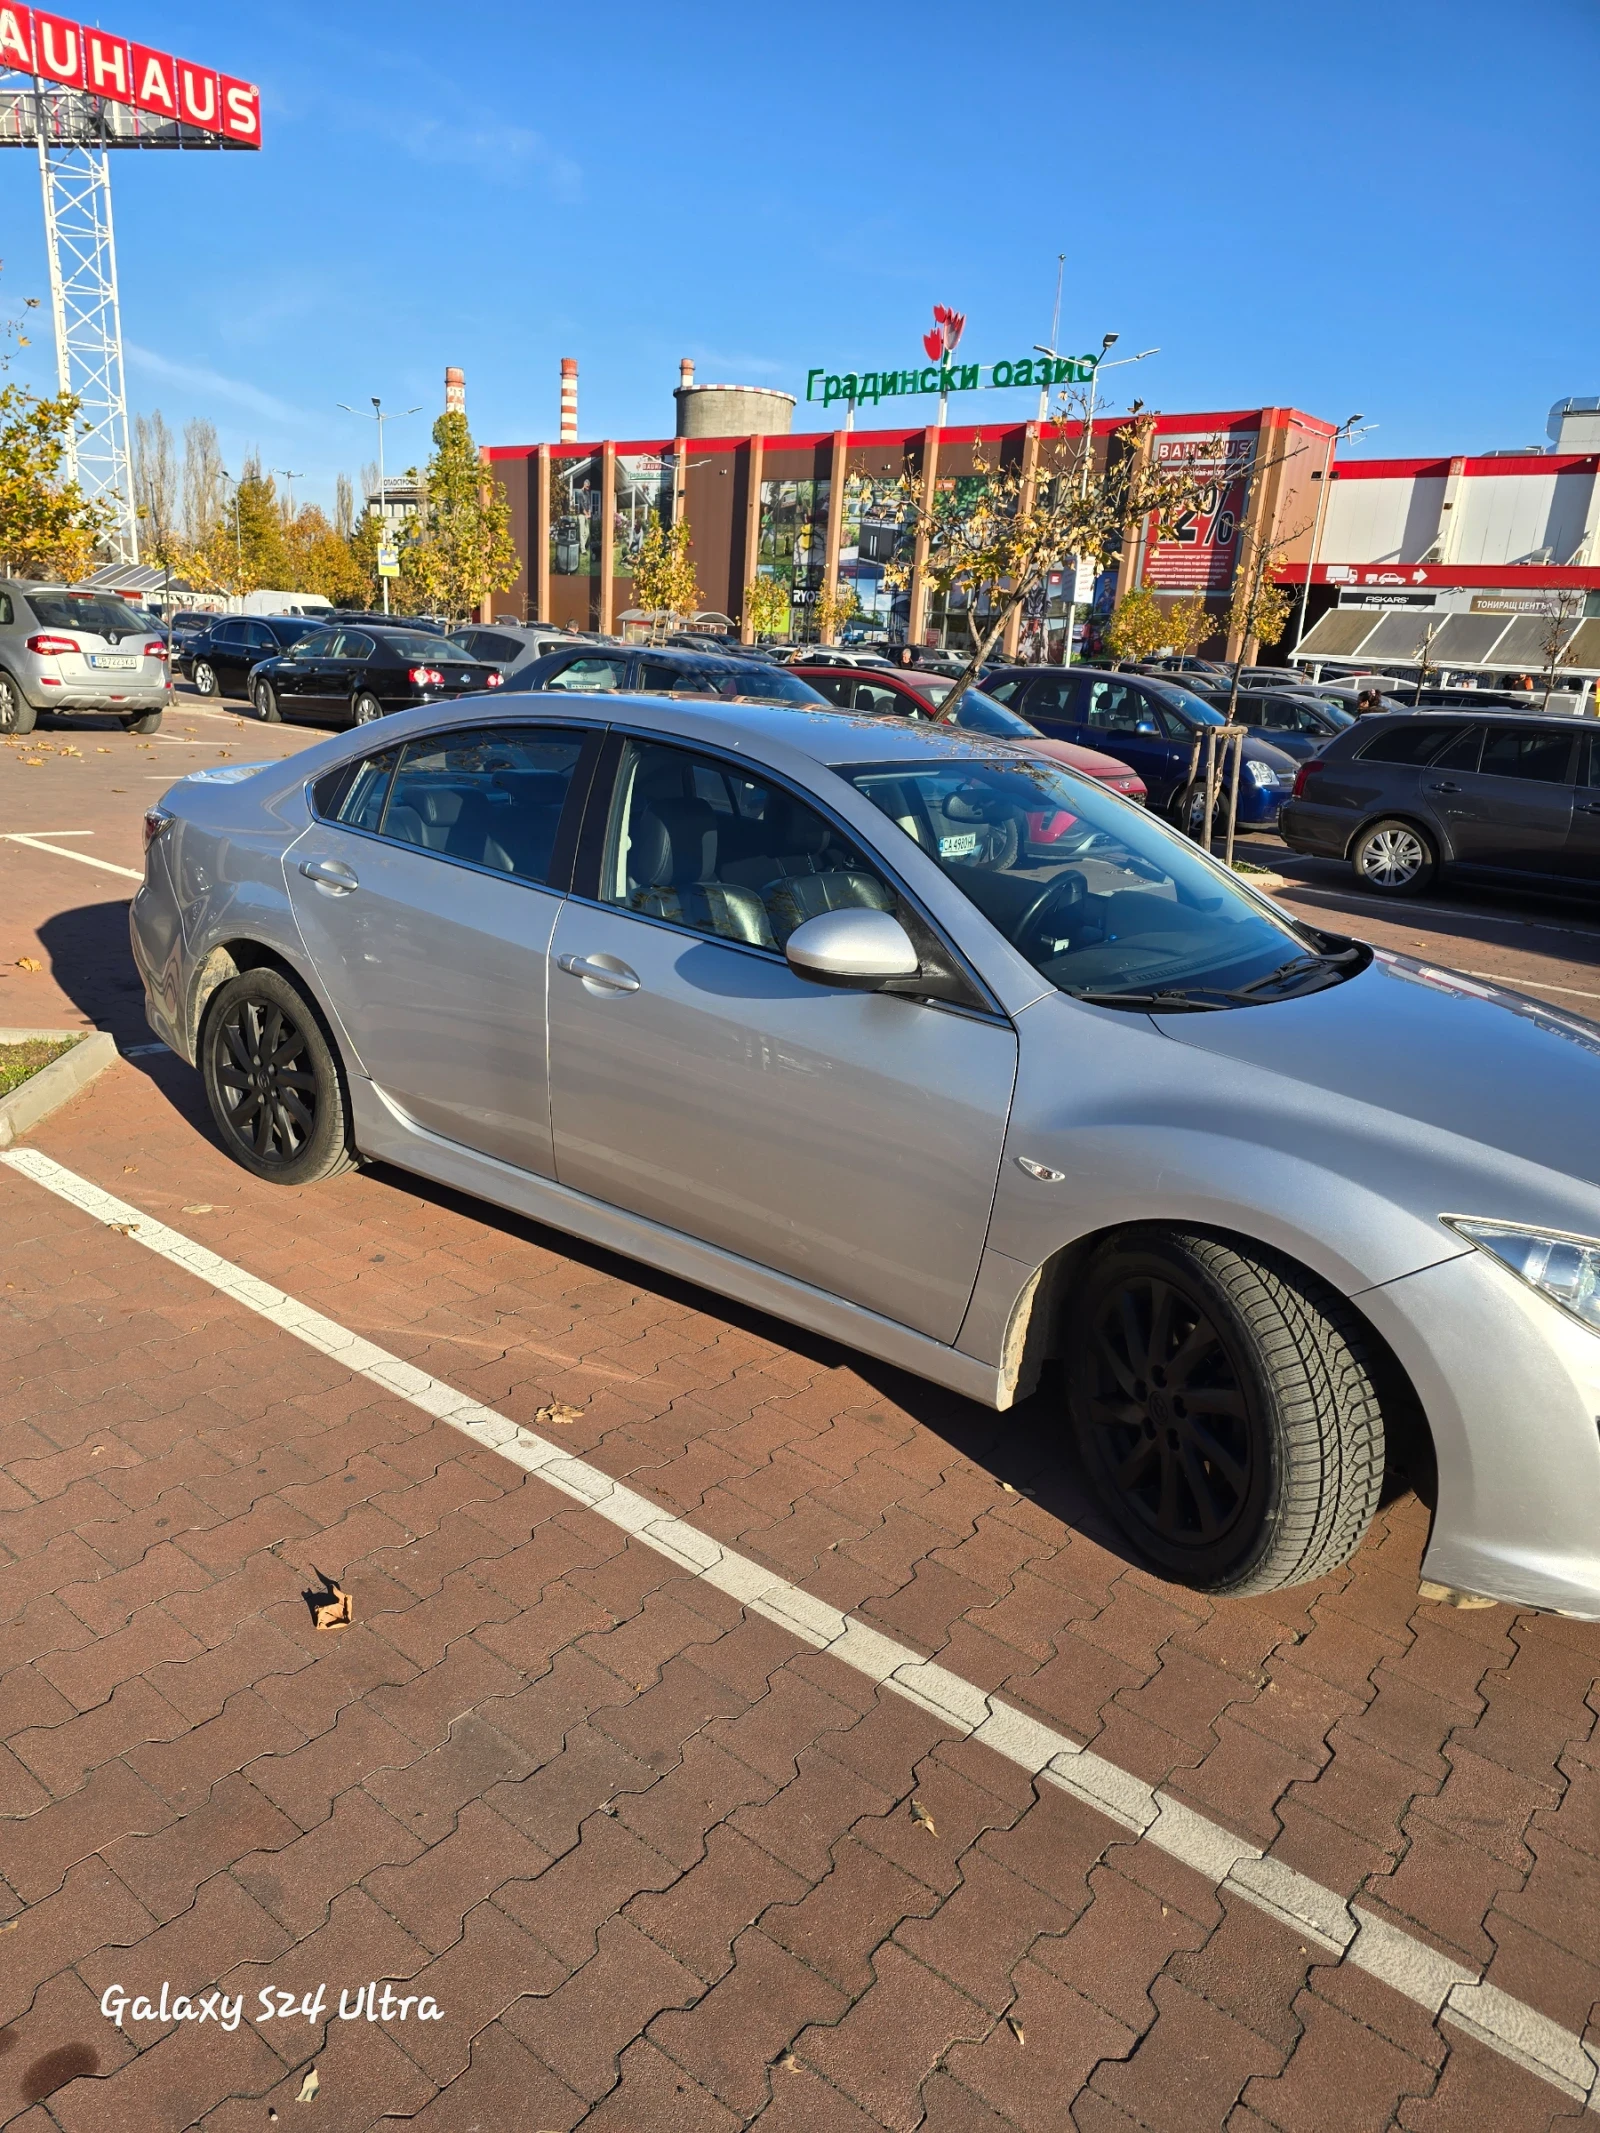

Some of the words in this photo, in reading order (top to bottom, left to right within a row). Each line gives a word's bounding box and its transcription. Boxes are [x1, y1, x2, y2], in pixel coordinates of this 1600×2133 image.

[806, 364, 980, 408] Градински
[992, 353, 1098, 387] оазис
[1160, 441, 1250, 458] BAUUS
[1365, 595, 1408, 604] FISKARS
[1477, 600, 1517, 611] ТОНИРАЩ
